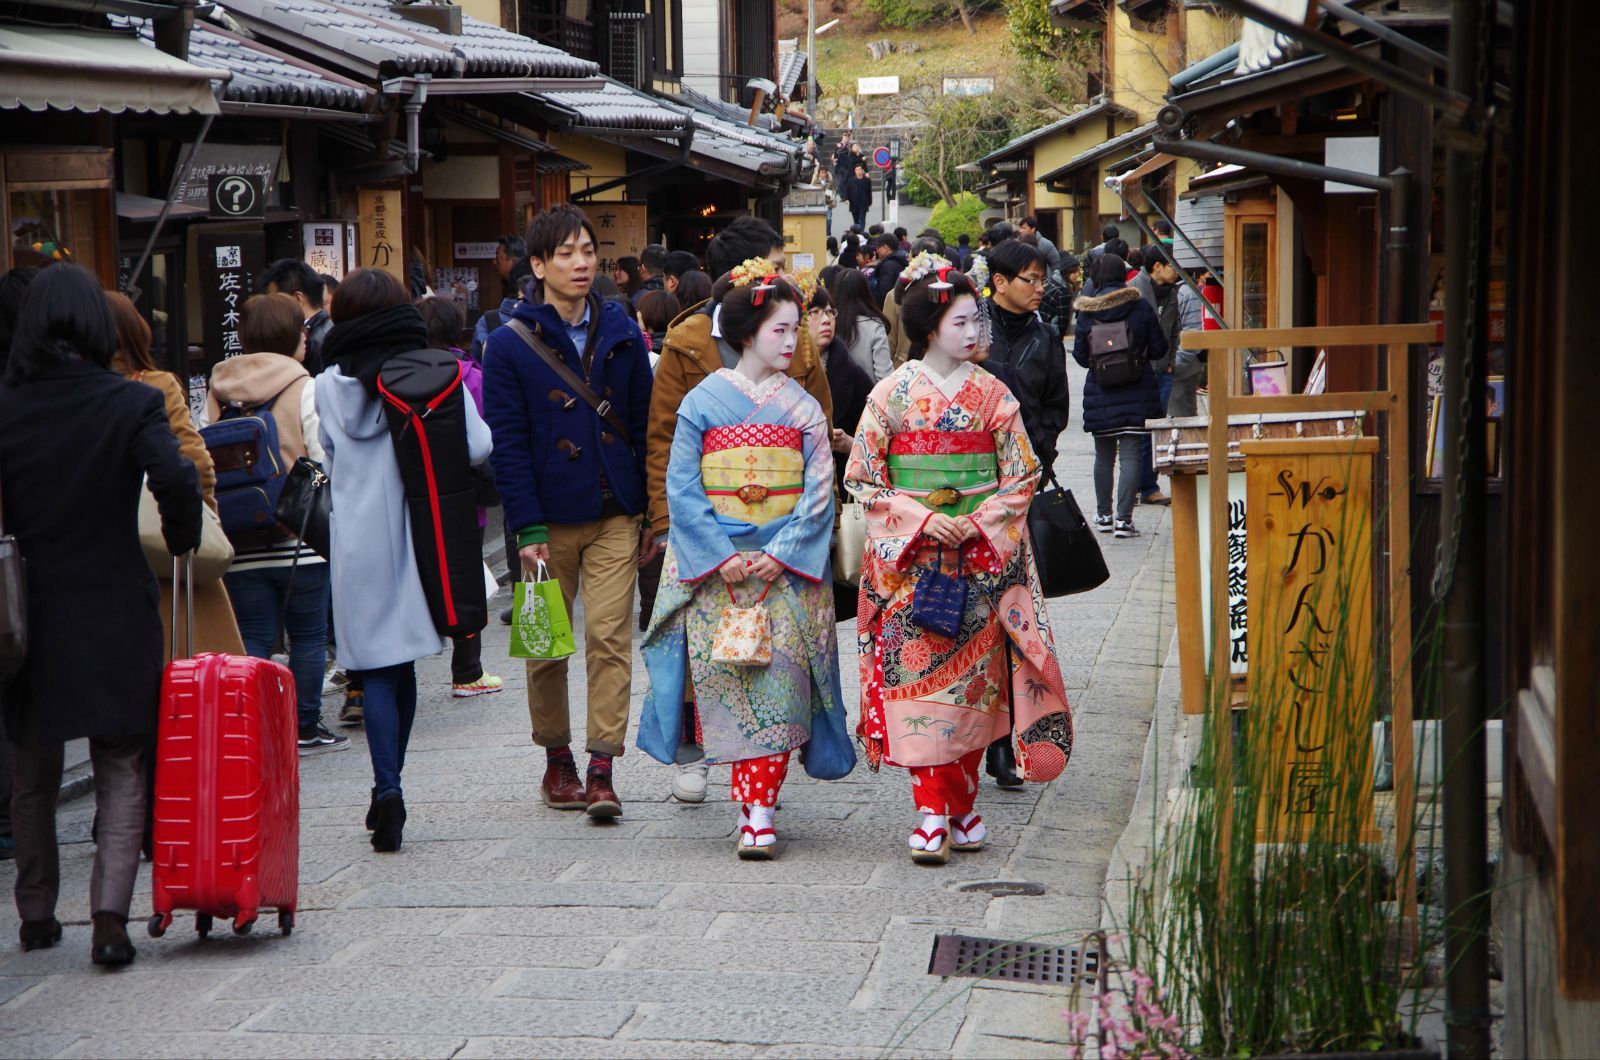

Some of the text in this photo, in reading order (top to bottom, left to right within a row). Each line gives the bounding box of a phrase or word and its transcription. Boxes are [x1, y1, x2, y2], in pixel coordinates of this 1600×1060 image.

[1284, 522, 1339, 816] かんざし屋
